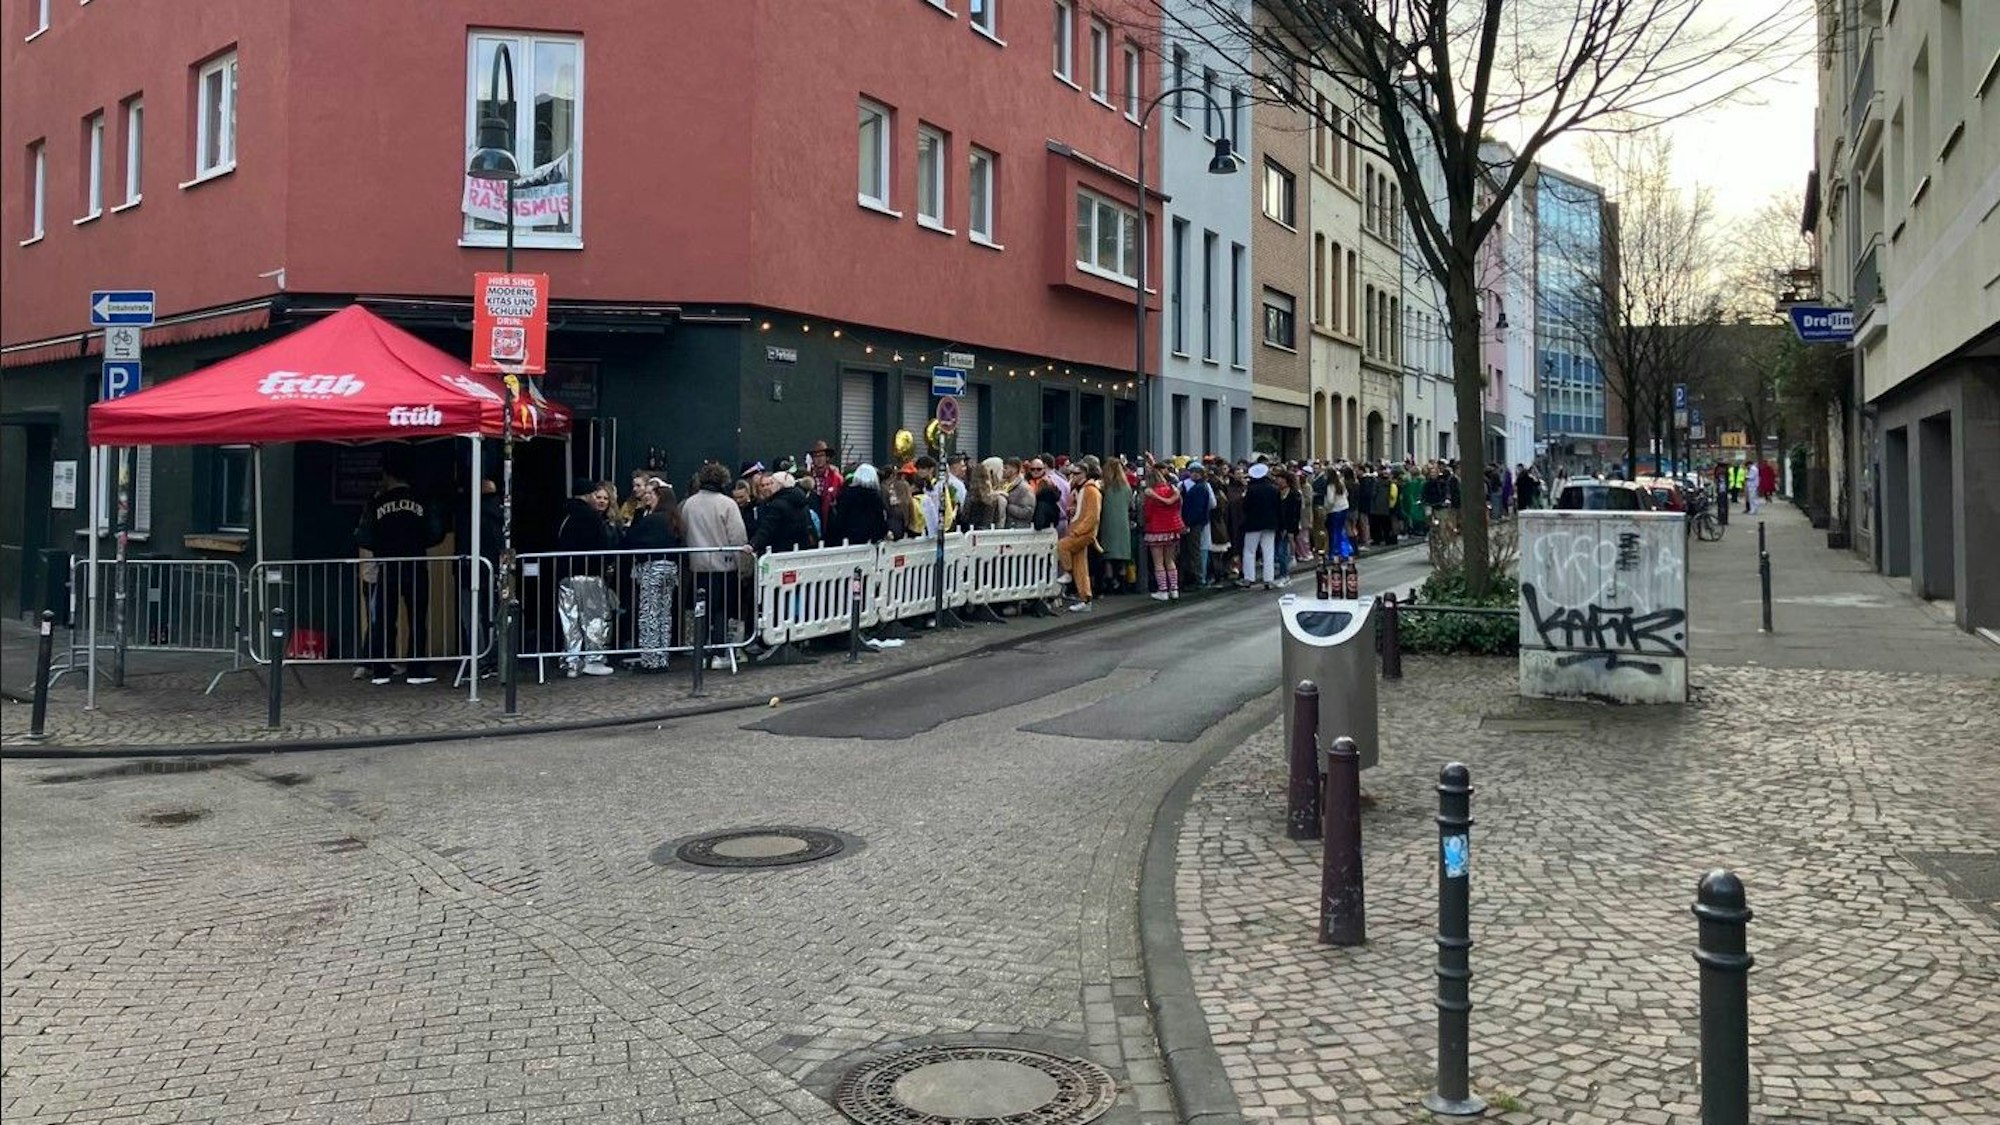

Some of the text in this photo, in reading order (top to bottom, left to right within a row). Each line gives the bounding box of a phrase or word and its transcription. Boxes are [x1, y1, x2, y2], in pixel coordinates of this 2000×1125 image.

[488, 277, 535, 287] HIER SIND
[488, 287, 535, 296] MODERNE
[487, 297, 535, 307] KITAS UND
[490, 307, 532, 316] SCHULEN
[496, 317, 523, 326] DRIN:
[109, 367, 129, 400] P
[258, 371, 366, 396] früh
[387, 404, 443, 427] früh
